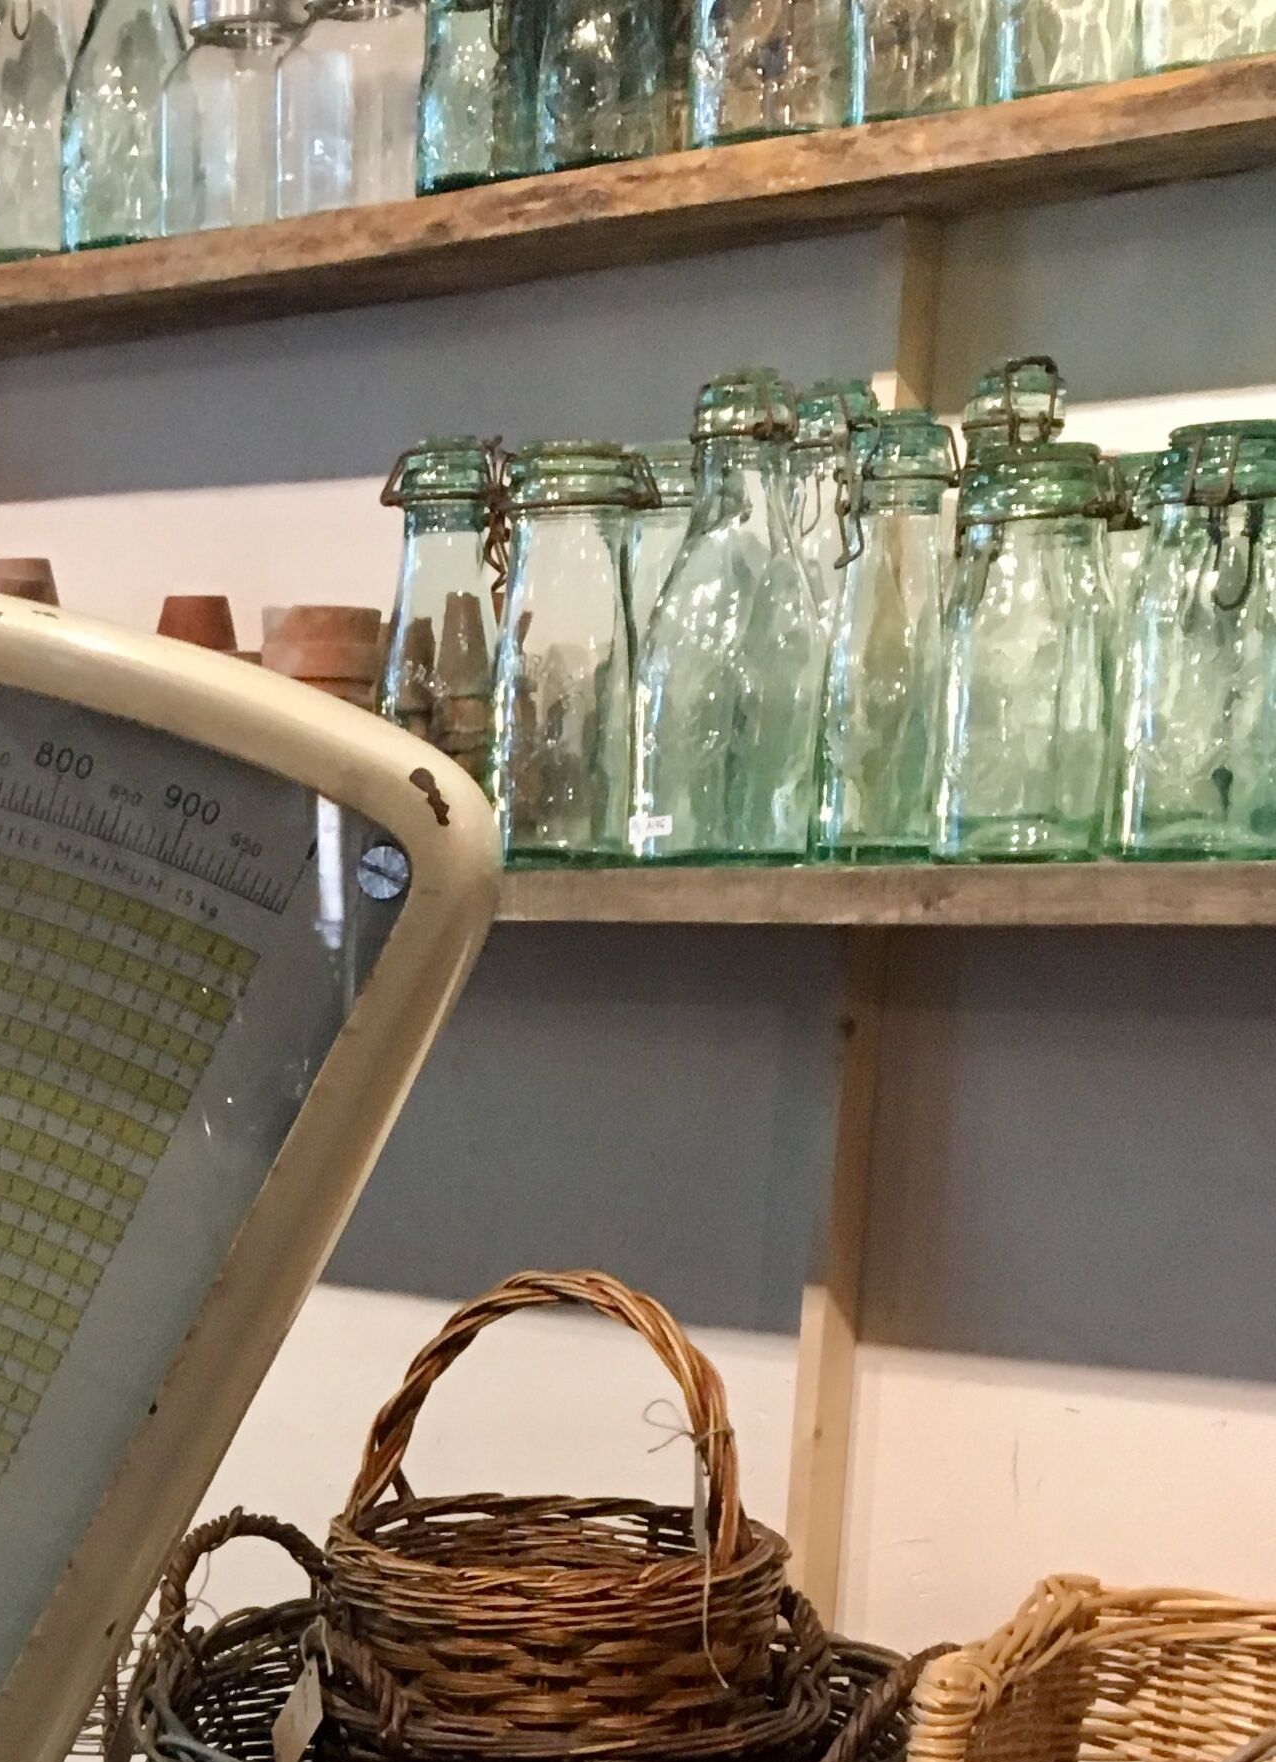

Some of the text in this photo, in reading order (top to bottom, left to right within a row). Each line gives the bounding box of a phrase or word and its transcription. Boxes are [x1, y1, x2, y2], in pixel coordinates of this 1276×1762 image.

[34, 741, 94, 780] 800
[163, 783, 223, 827] 900
[54, 840, 165, 895] MAXIMUM
